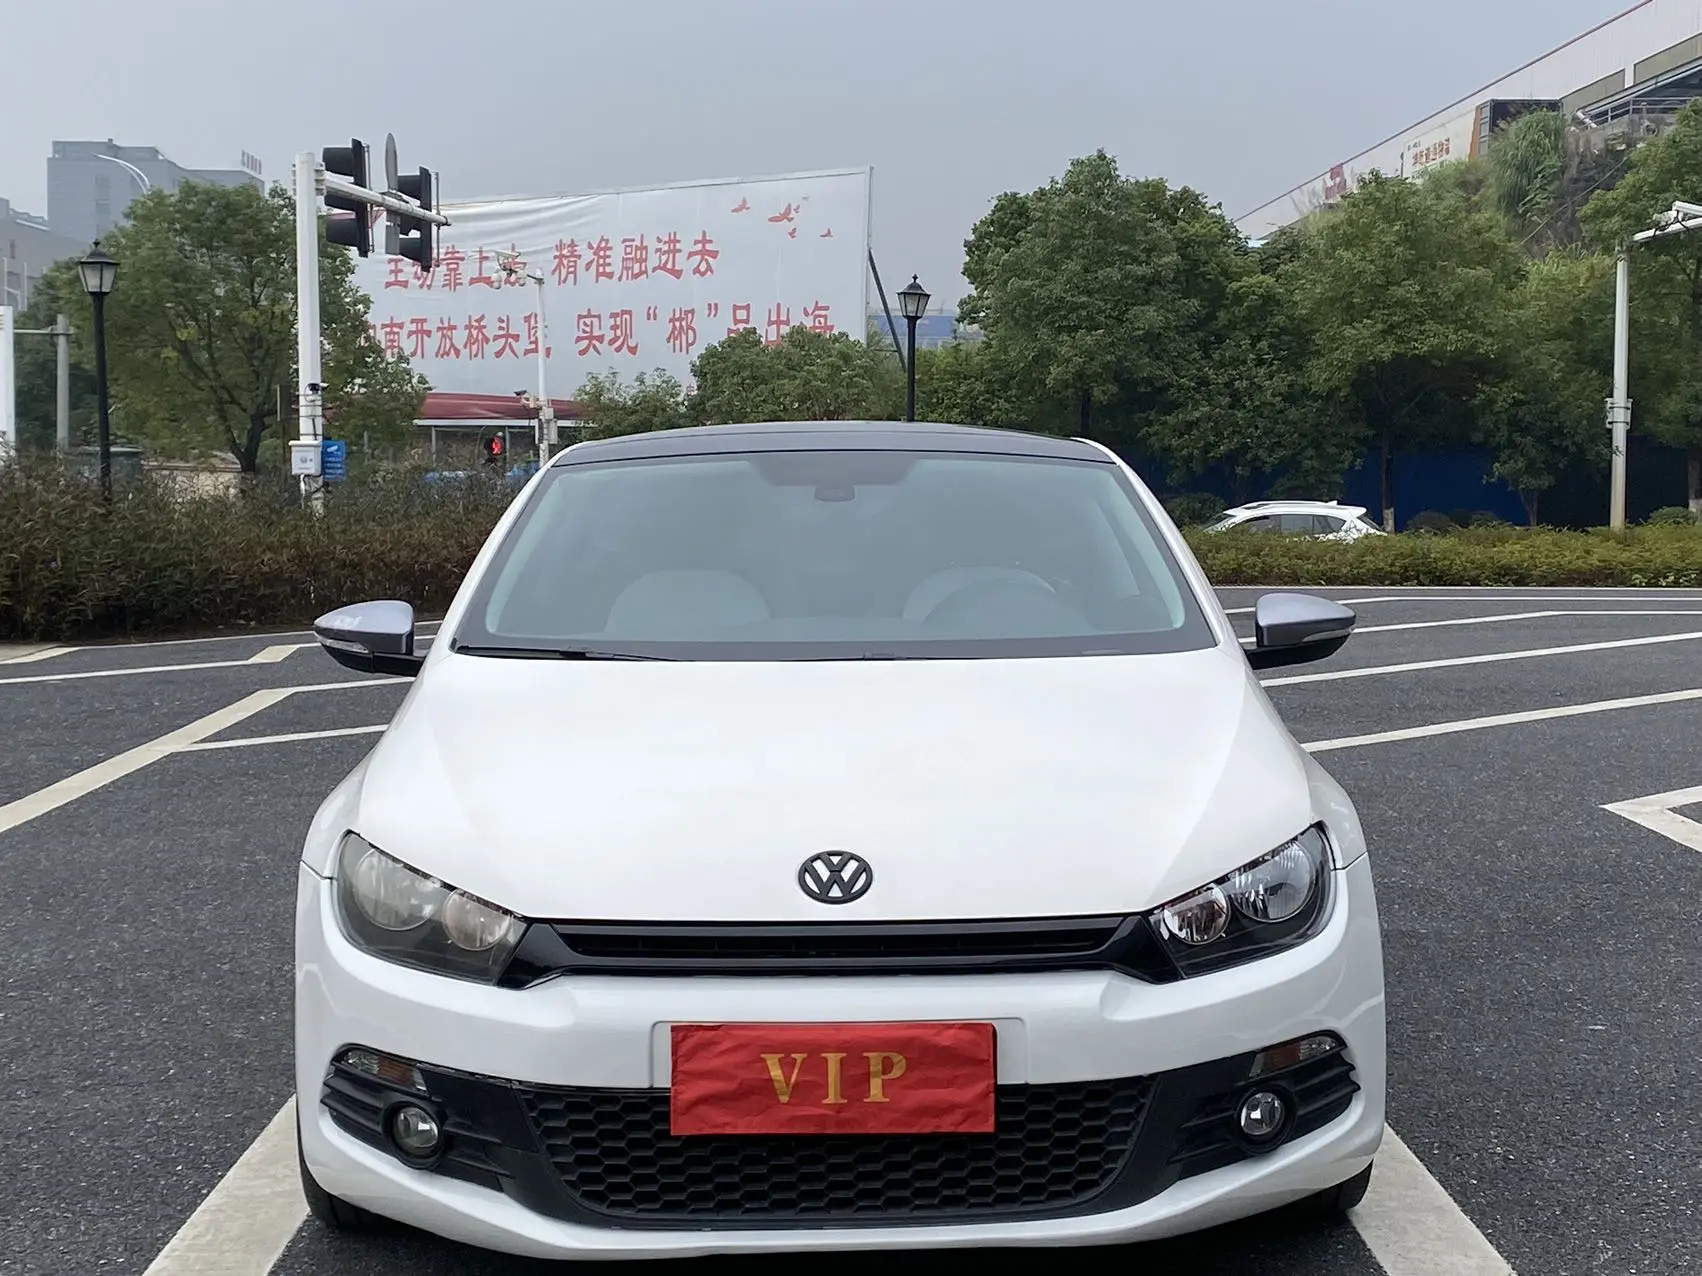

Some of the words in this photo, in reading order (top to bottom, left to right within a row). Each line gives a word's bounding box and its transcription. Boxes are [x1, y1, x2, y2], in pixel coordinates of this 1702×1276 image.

[551, 230, 720, 286] 精准融进去
[761, 1052, 907, 1105] VIP
